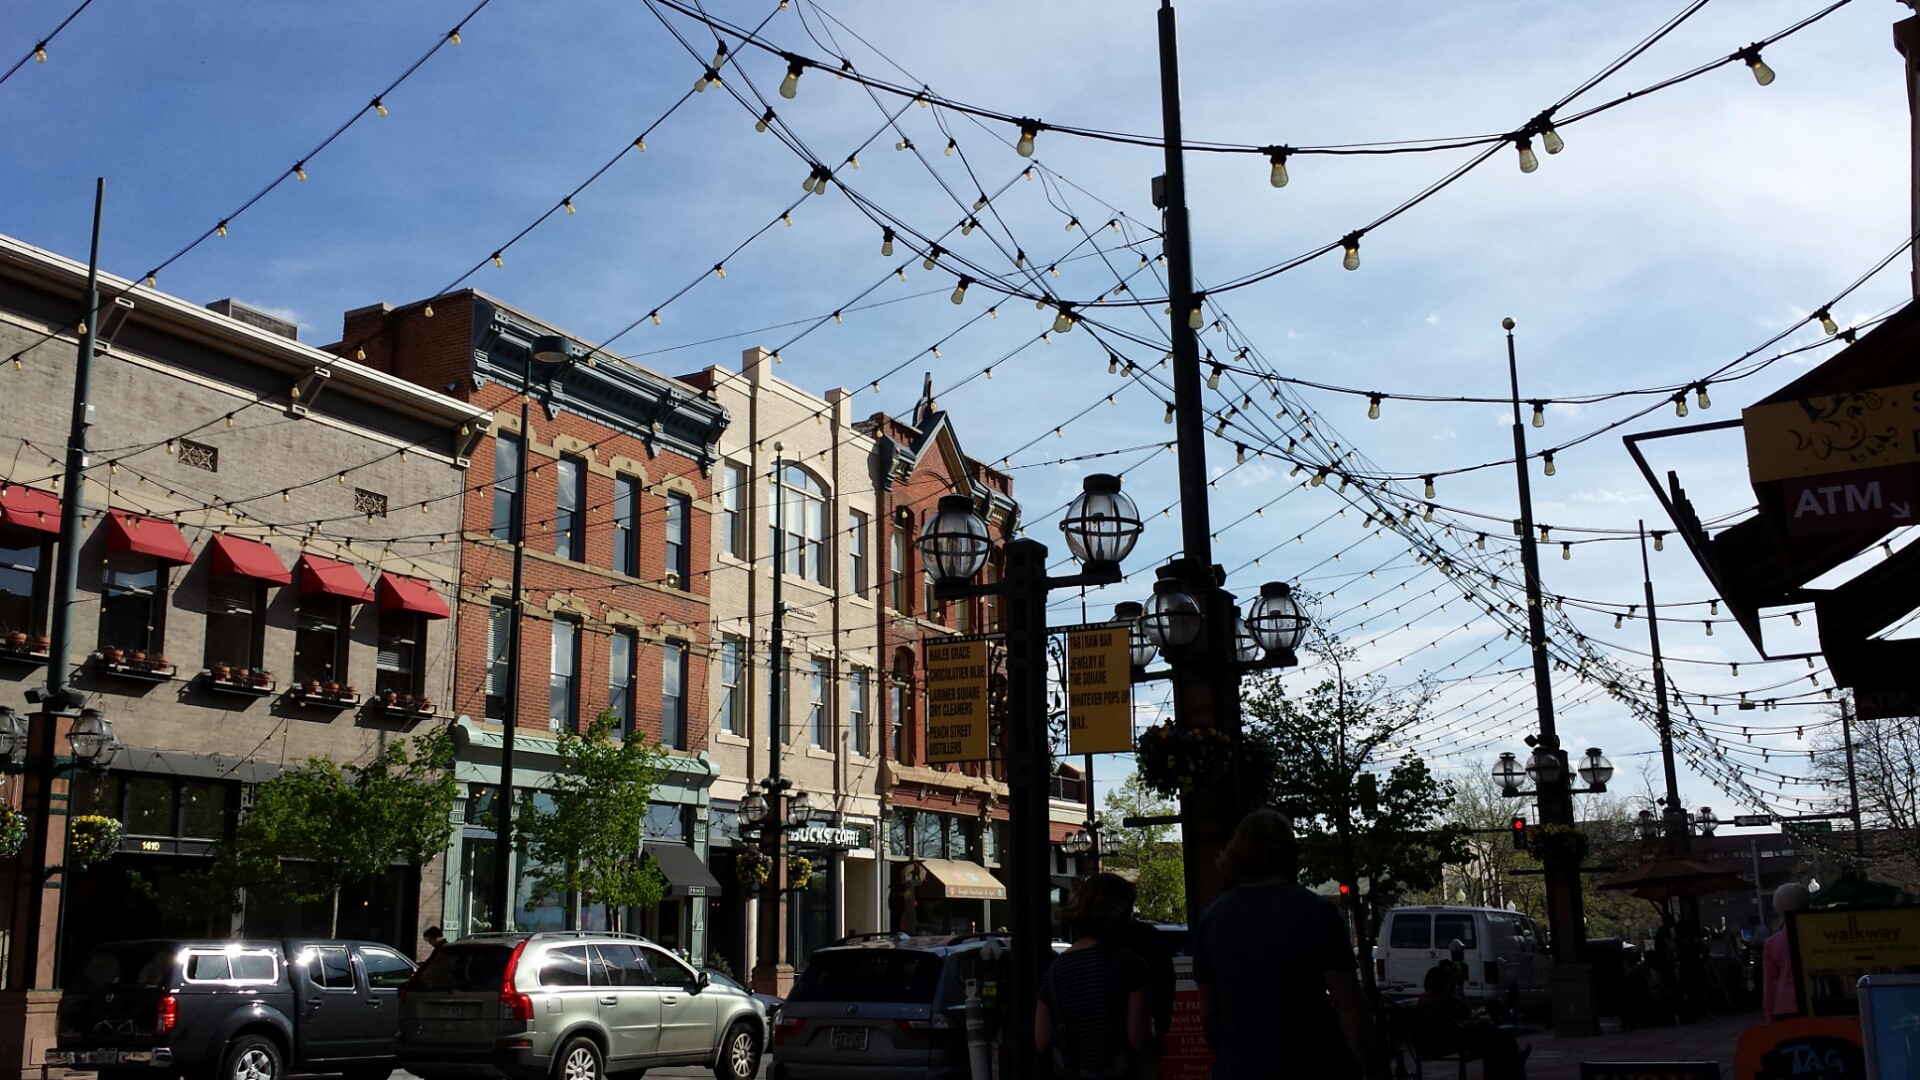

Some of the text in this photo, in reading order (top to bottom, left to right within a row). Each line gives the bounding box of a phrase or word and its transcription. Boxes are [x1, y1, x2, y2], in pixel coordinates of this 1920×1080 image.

[1794, 481, 1883, 518] ATM
[1069, 636, 1081, 650] TAG
[1085, 634, 1098, 648] RAW
[1100, 633, 1113, 647] BAR
[929, 646, 970, 661] HAILEE GRACE
[1070, 654, 1106, 671] JEWELRY AT
[929, 665, 985, 682] CHOCOLATIER BLUE
[1070, 670, 1107, 686] THE SQUARE
[929, 686, 980, 702] LARIMER SQUARE
[1070, 690, 1130, 707] WHATEVER POPS UP
[929, 702, 973, 717] DRY CLEANERS
[1070, 715, 1088, 729] WAX.
[929, 724, 972, 739] PEACH STREET
[929, 741, 962, 756] DISTILLERS
[142, 841, 161, 851] 1410
[1823, 915, 1901, 941] walkway
[1170, 1015, 1189, 1023] Valet
[1782, 1044, 1845, 1074] TAG
[1184, 1064, 1208, 1072] Dinner
